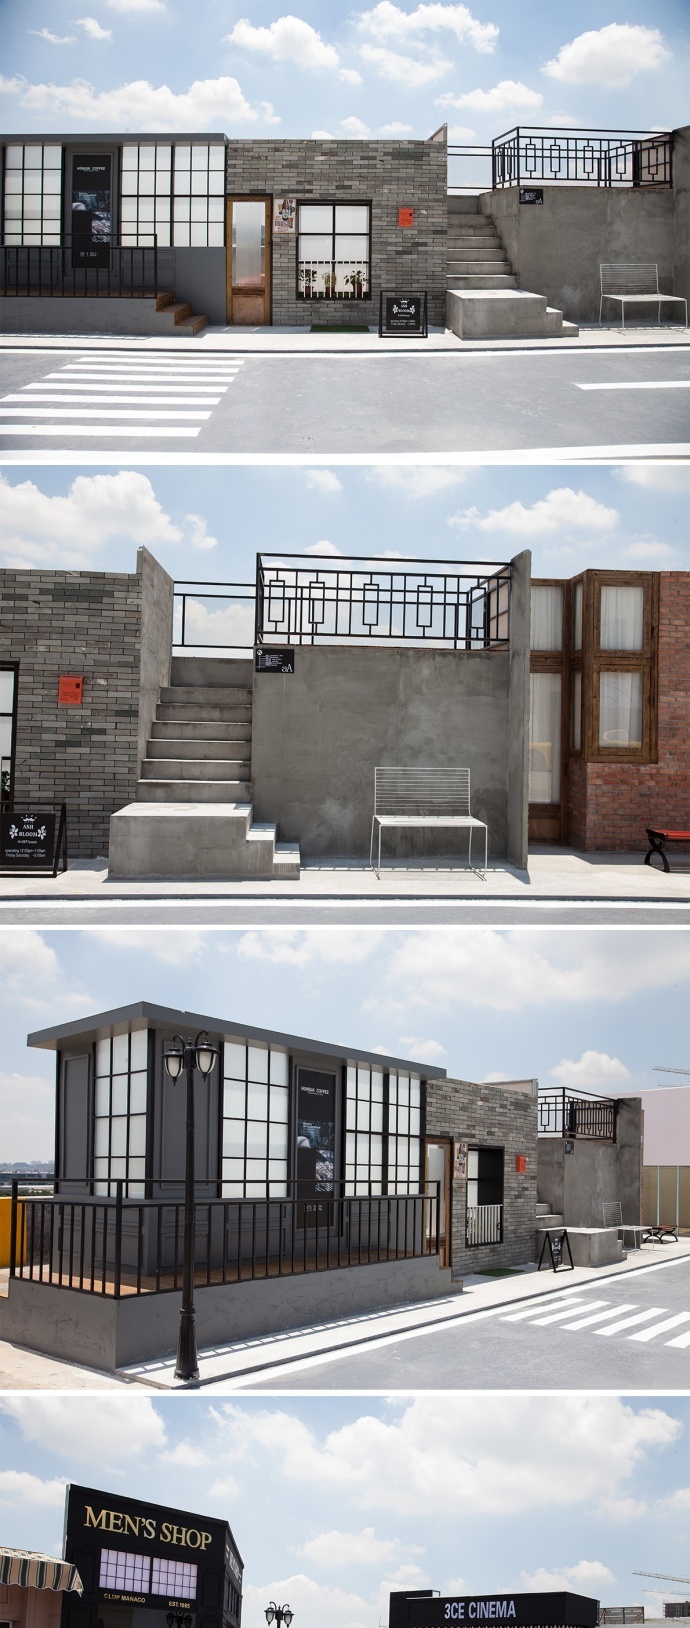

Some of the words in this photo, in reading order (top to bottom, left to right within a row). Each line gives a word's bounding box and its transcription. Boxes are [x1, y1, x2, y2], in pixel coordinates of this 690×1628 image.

[84, 1505, 156, 1539] MEN'S
[160, 1523, 212, 1550] SHOP
[444, 1602, 465, 1619] 3CE
[468, 1600, 516, 1618] CINEMA
